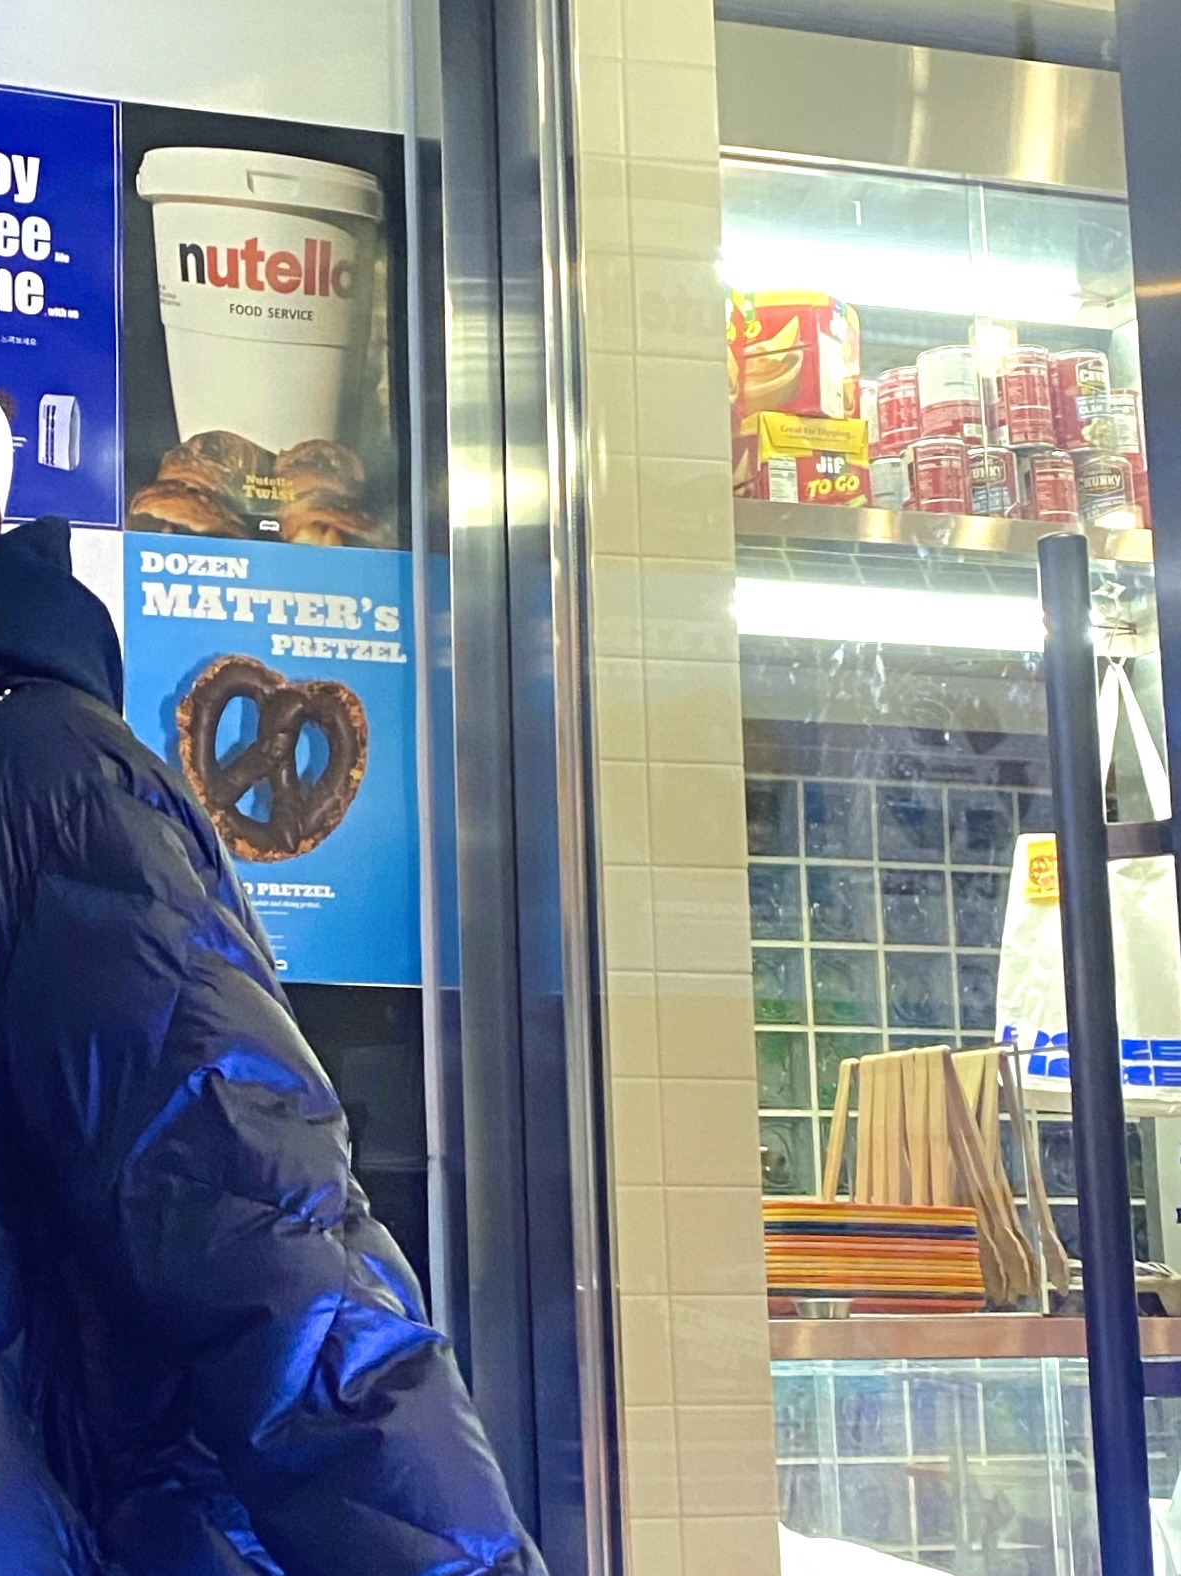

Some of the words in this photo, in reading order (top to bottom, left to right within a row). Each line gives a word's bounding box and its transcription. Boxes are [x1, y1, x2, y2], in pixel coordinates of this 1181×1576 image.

[229, 303, 263, 318] FOOD
[267, 307, 314, 321] SERVICE
[807, 479, 833, 499] TO
[834, 475, 861, 493] GO
[140, 551, 250, 579] DOZEN
[271, 634, 408, 663] PRETZEL
[257, 883, 336, 899] PRETZEL
